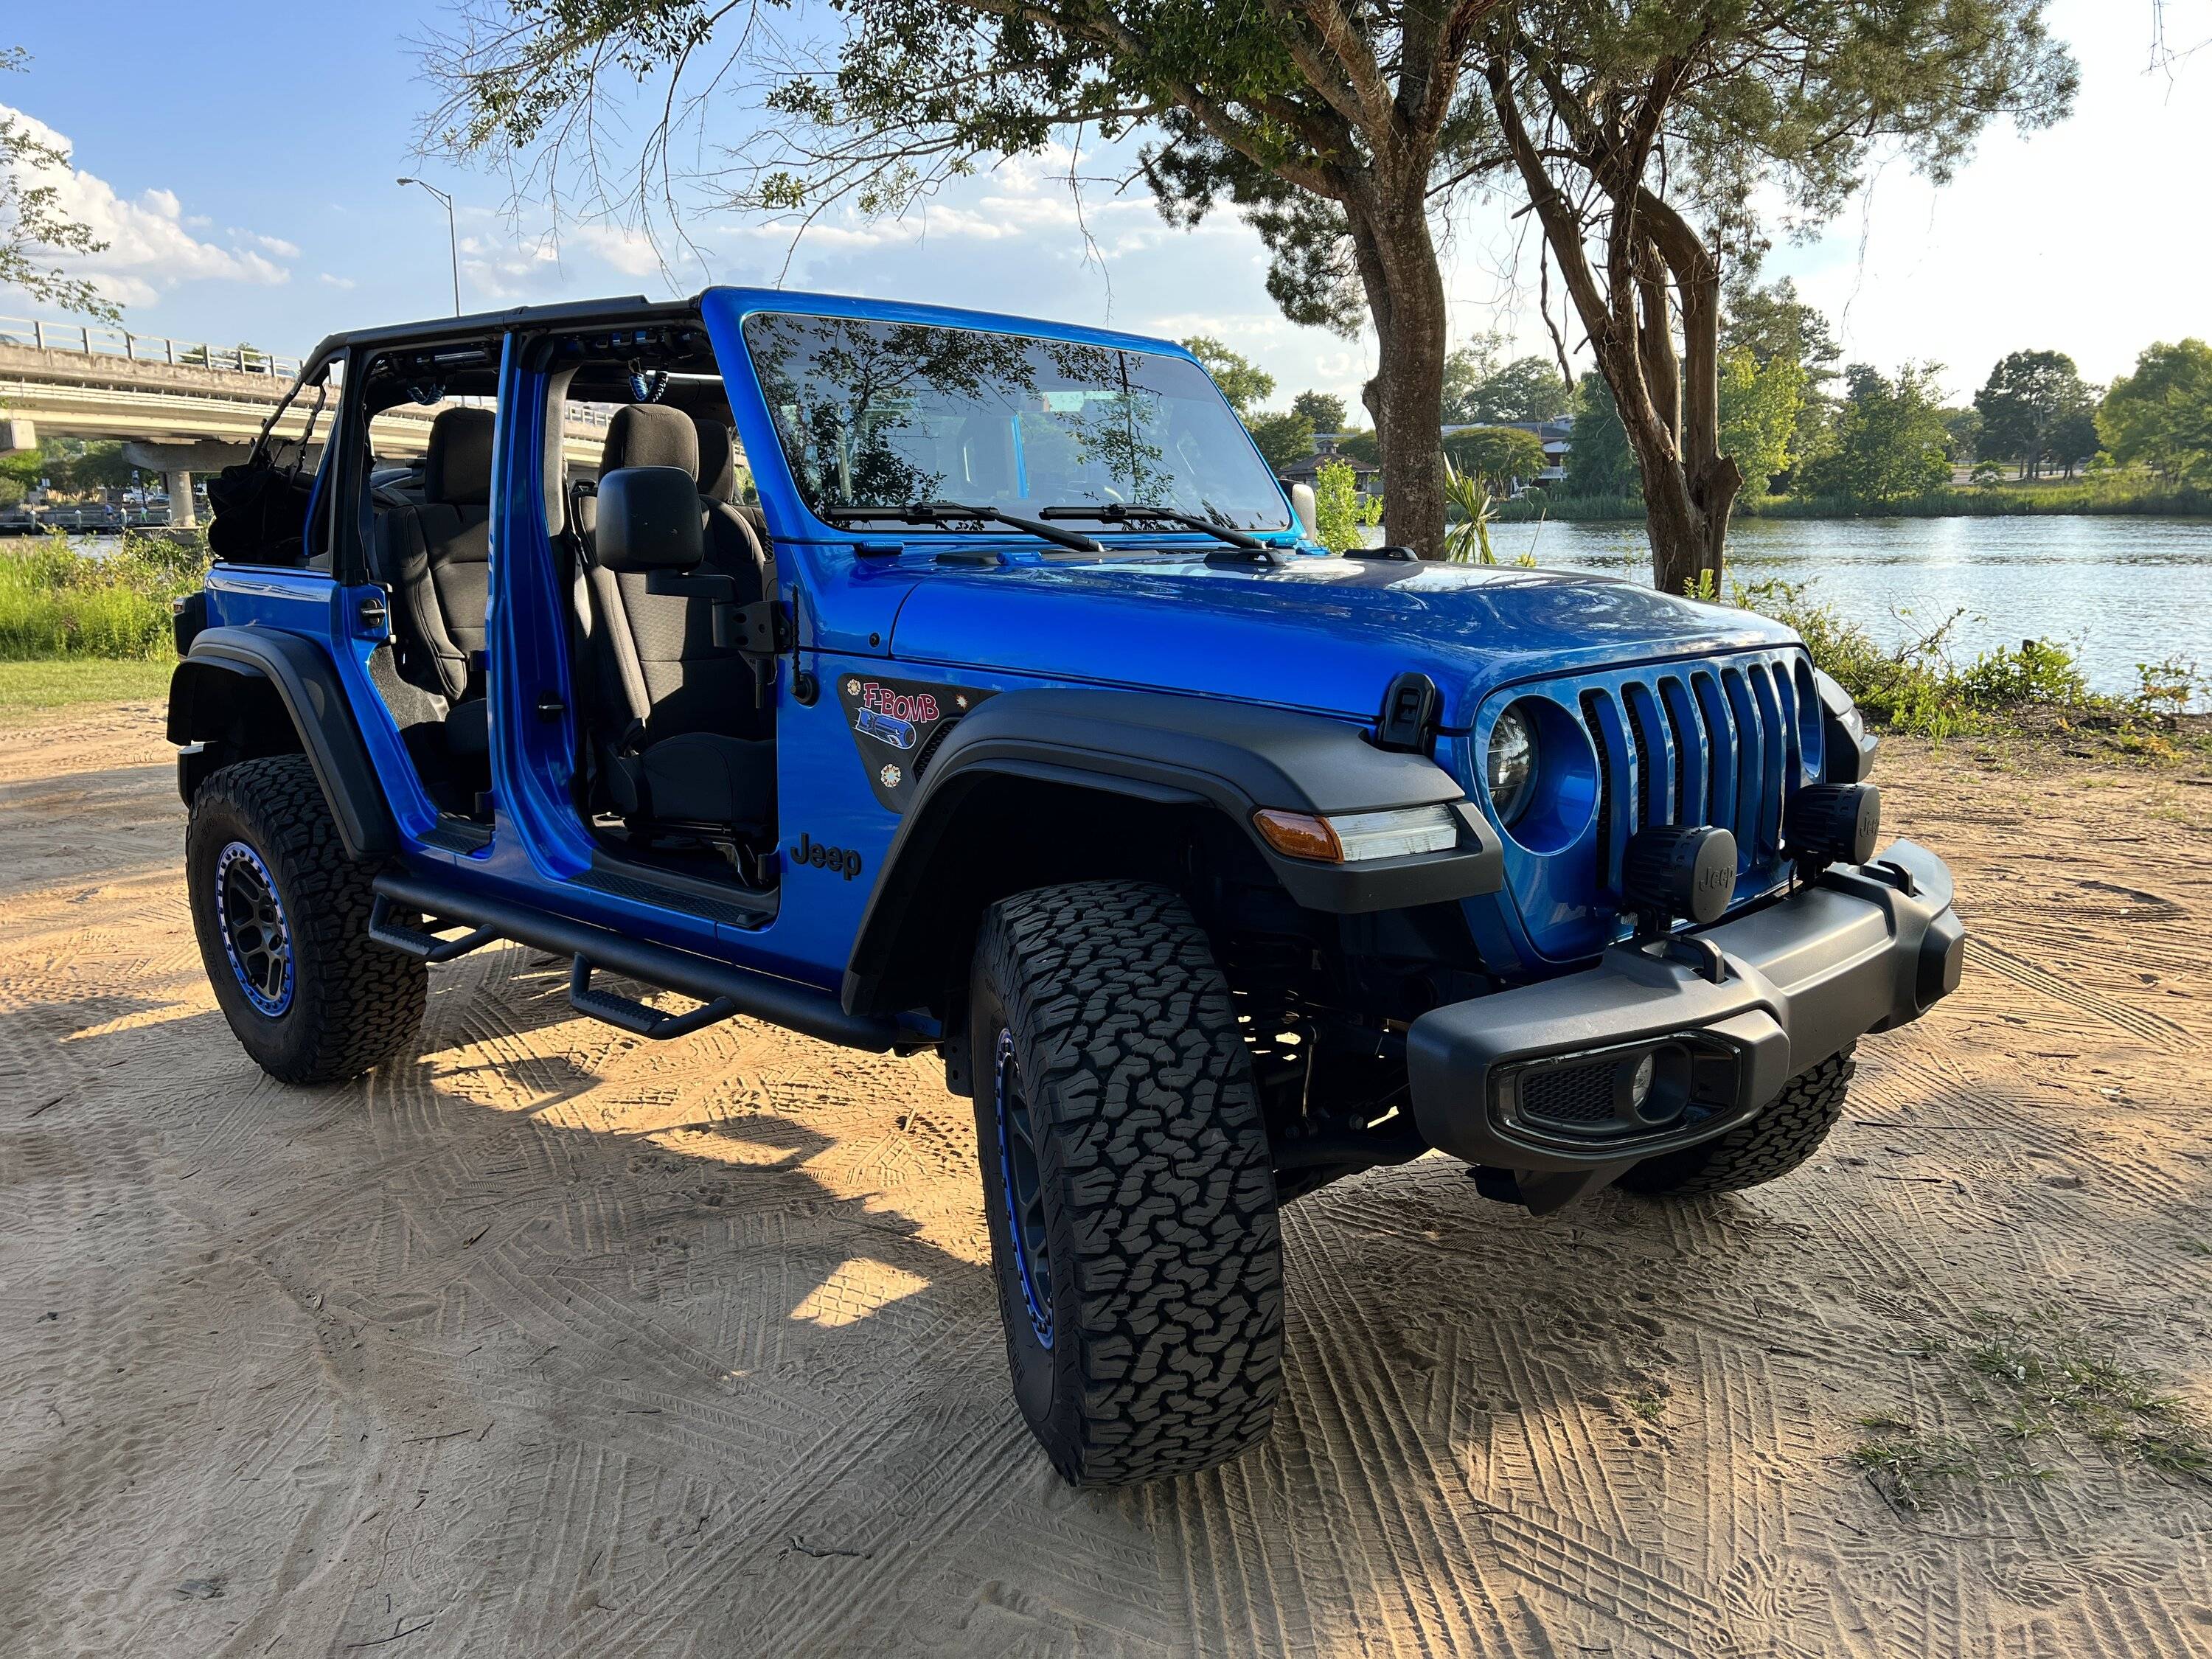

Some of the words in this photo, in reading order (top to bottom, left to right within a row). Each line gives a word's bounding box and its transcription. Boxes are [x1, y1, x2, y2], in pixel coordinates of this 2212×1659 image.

[863, 683, 939, 723] F-BOMB
[790, 832, 862, 881] Jeep
[1699, 865, 1735, 892] Jeep
